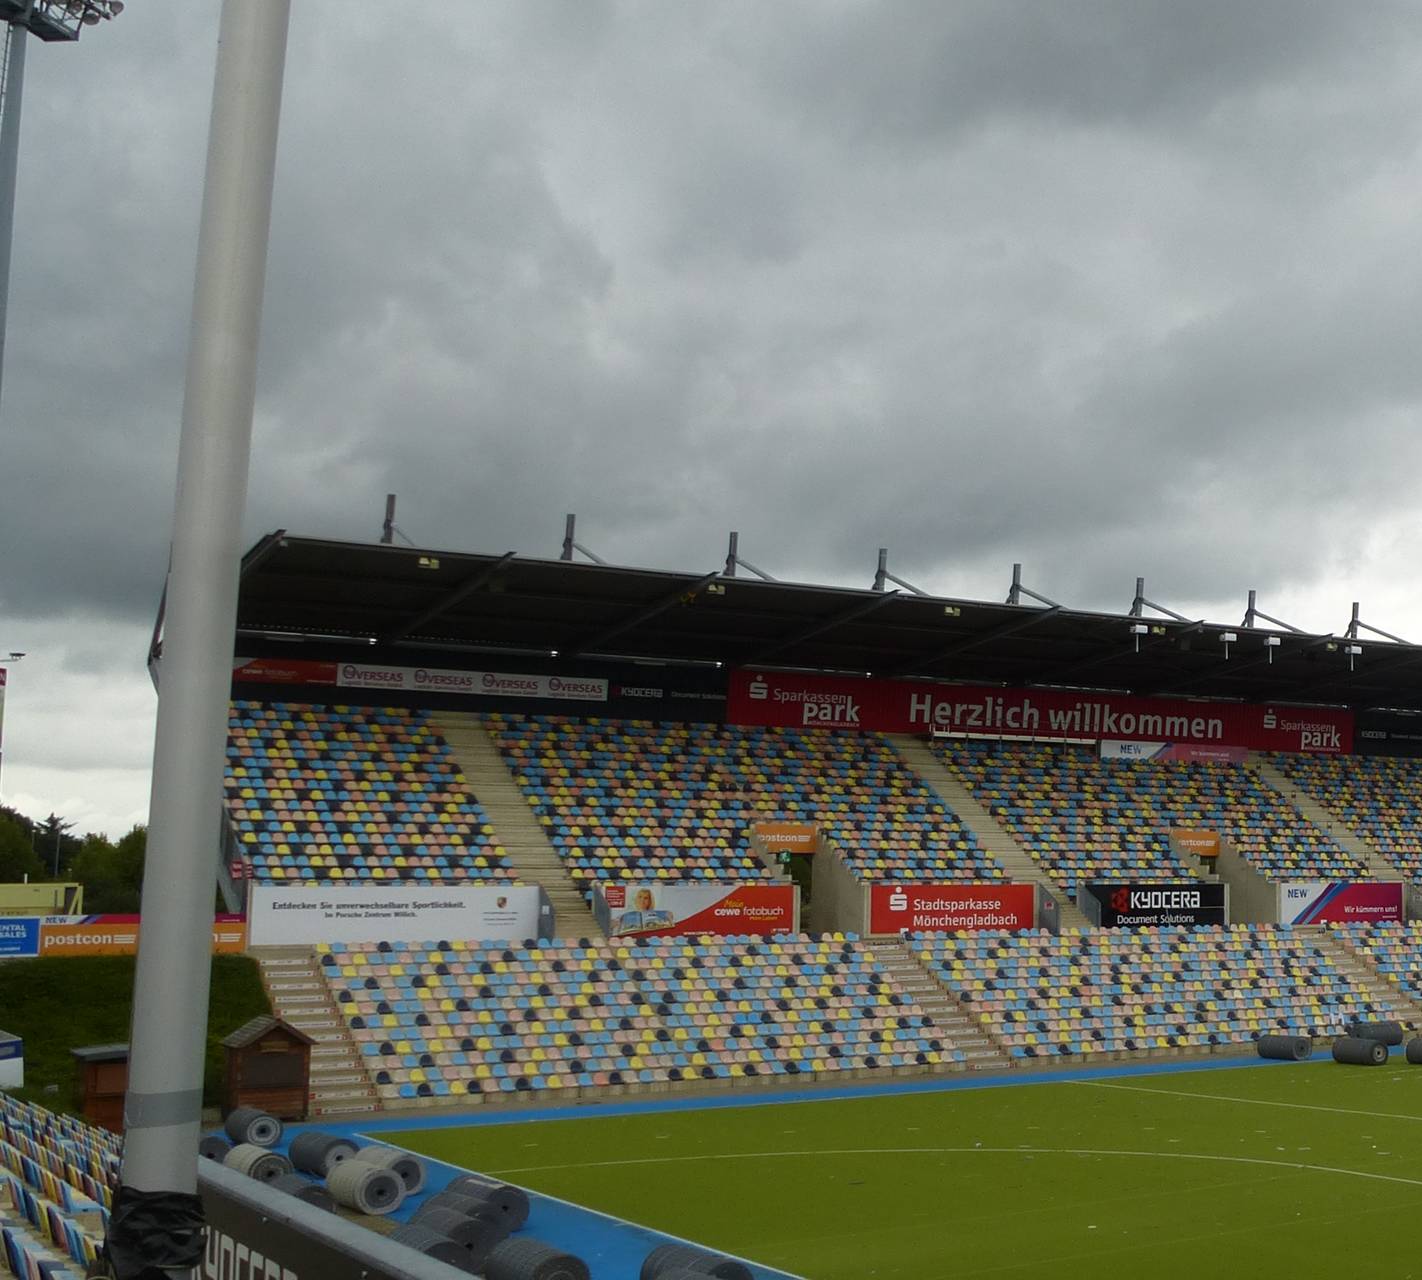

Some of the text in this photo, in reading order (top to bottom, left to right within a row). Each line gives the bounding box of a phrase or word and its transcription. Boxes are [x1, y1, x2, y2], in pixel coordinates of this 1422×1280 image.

[343, 665, 403, 682] OVERSEAS
[414, 669, 473, 686] OVERSEAS
[483, 673, 538, 690] OVERSEAS
[549, 678, 602, 694] OVERSEAS
[621, 687, 663, 698] KYOCERA
[773, 688, 847, 704] Sparkassen
[803, 696, 860, 725] park
[909, 693, 1224, 739] Herzlich willkommen
[1280, 719, 1332, 733] Sparkassen
[1301, 725, 1341, 750] park
[1120, 744, 1142, 755] NEW
[1131, 891, 1200, 908] KYOCERA
[1287, 888, 1307, 899] NEW
[272, 901, 466, 912] Entdecken Sie unverwechselbare Sportlichkeit.
[724, 900, 744, 908] Mein
[913, 898, 1001, 912] Stadtsparkasse
[1344, 904, 1398, 913] Wir kümmern uns!
[335, 911, 362, 919] Porsche
[714, 906, 784, 917] cewe fotobuch
[913, 914, 1017, 929] Mönchengladbach
[1117, 914, 1195, 925] Document Solutions
[45, 933, 112, 948] postcon
